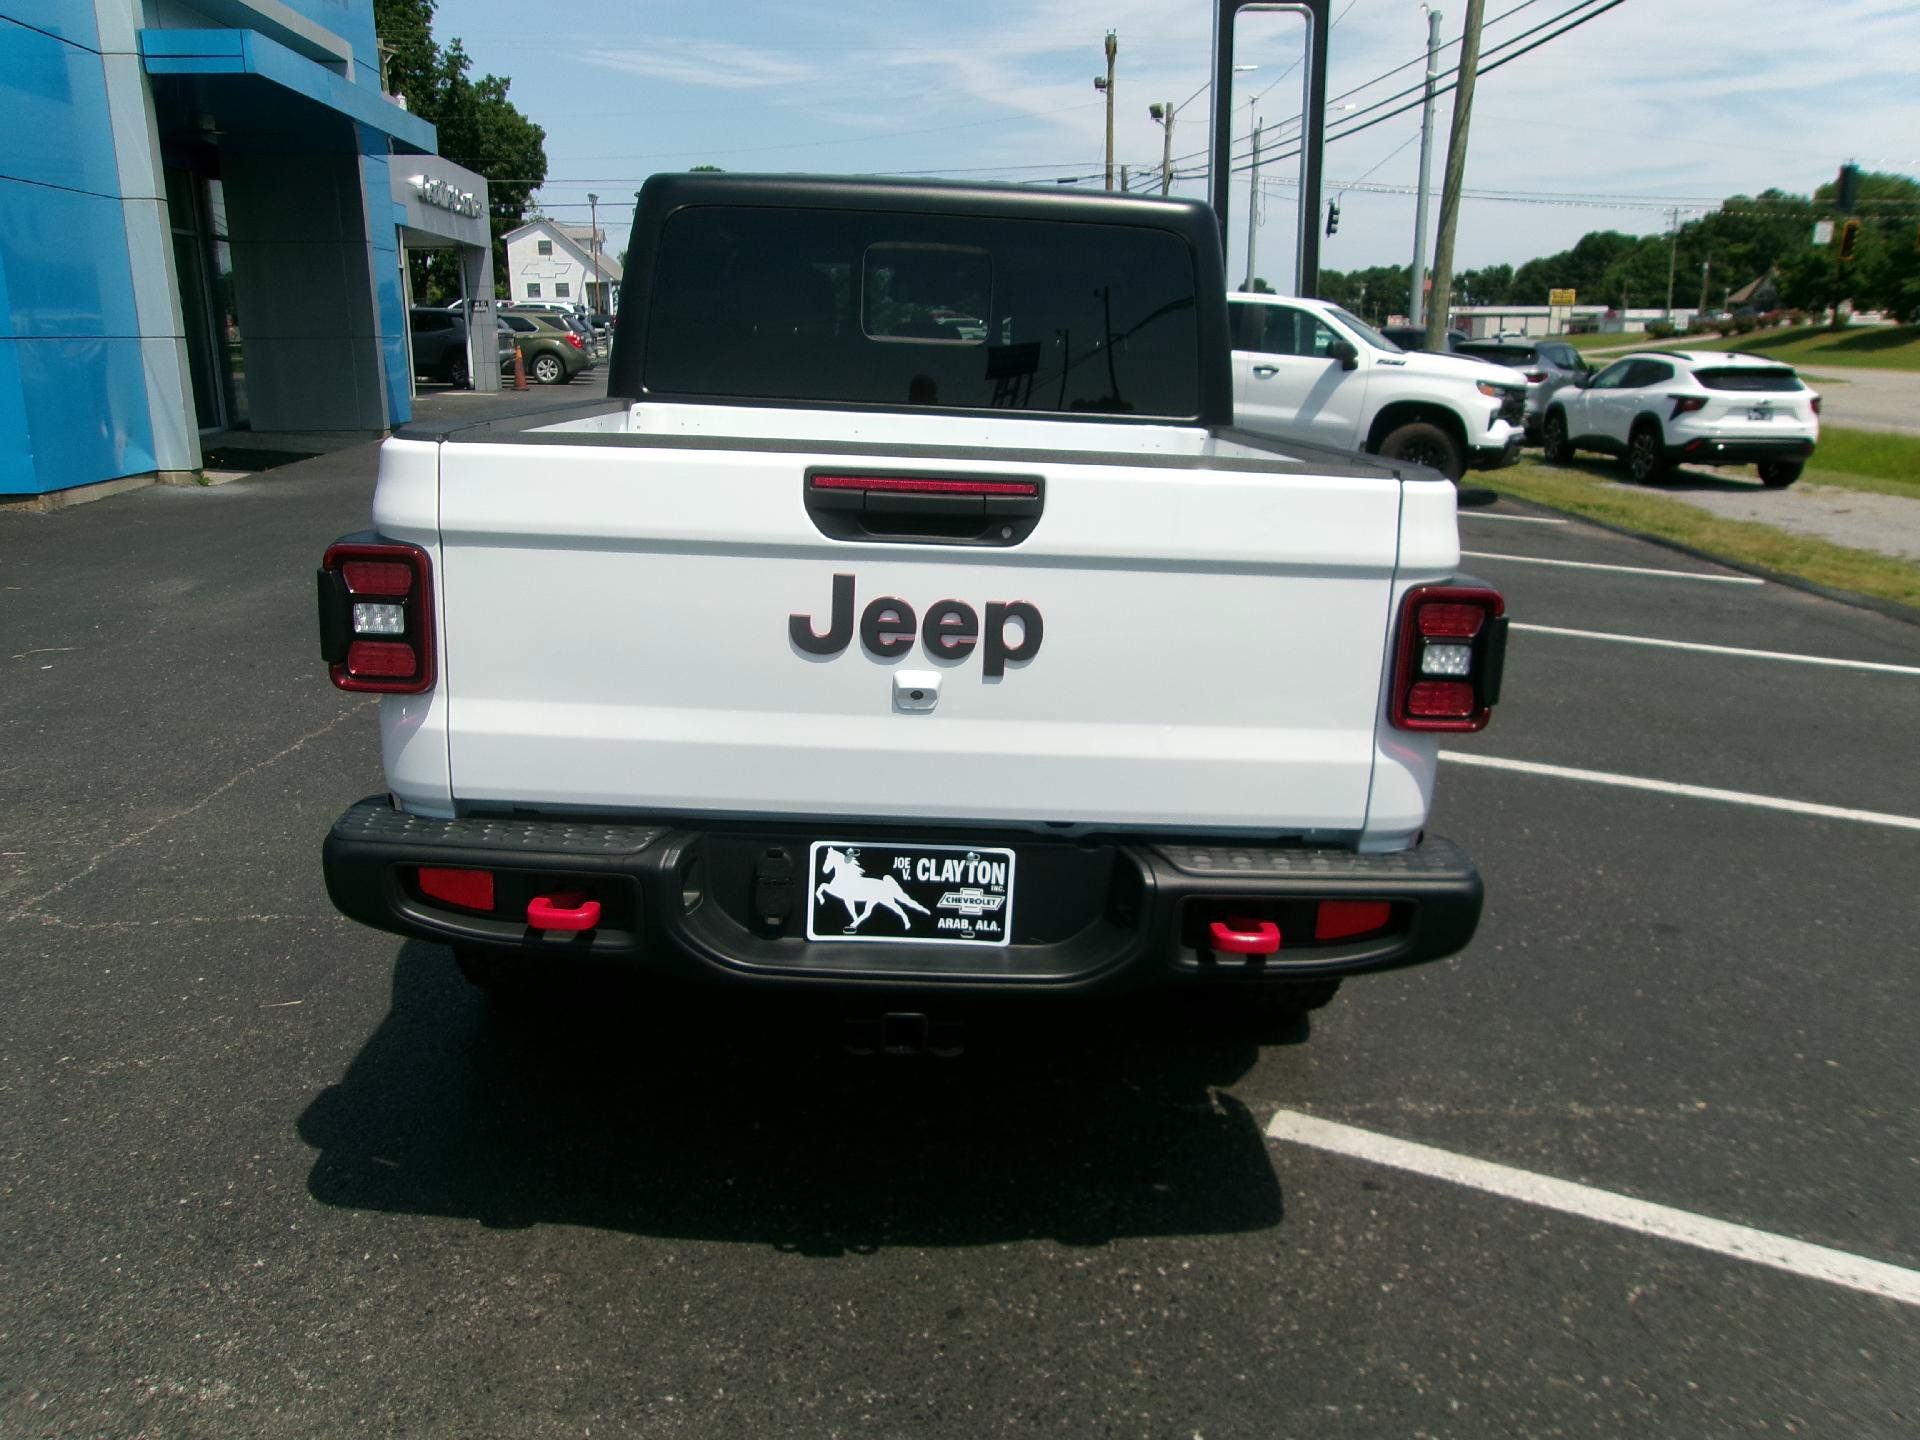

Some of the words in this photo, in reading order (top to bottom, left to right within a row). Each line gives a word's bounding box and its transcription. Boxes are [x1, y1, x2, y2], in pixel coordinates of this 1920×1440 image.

[789, 573, 1044, 677] Jeep
[893, 857, 911, 869] JOE
[902, 868, 911, 880] V.
[916, 858, 1006, 885] CLAYTON
[945, 896, 997, 906] CHEVROLET
[937, 917, 973, 930] ARAB,
[975, 920, 1001, 931] ALA.
